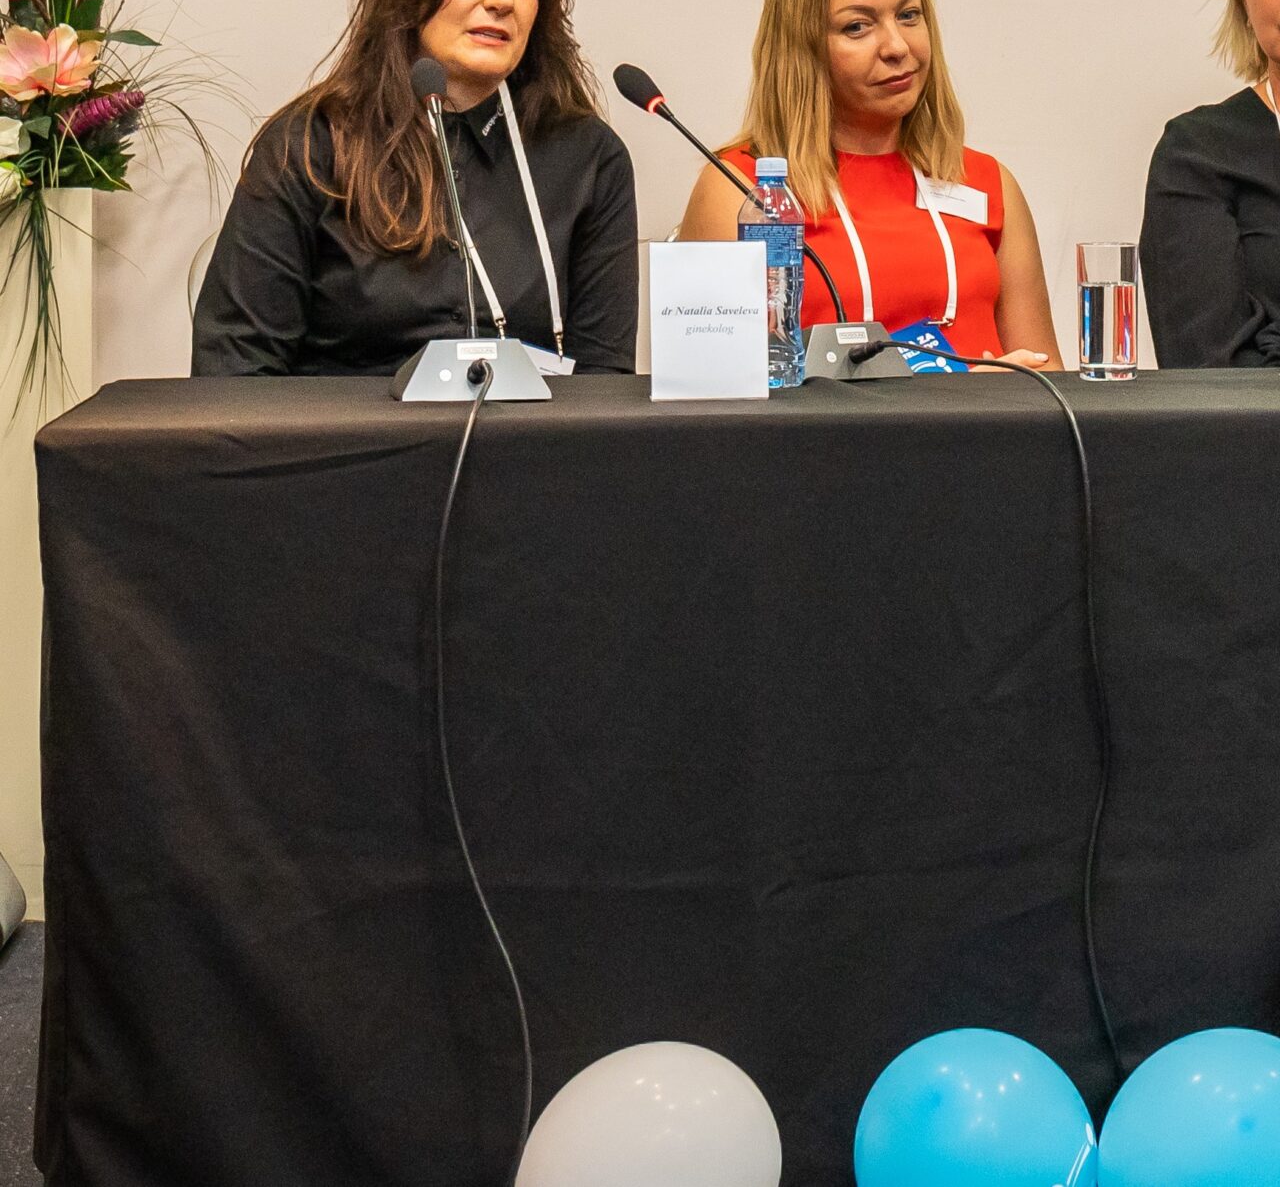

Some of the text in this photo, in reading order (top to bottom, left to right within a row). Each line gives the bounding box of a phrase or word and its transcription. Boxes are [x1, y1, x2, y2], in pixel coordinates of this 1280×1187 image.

[661, 305, 759, 316] dr Natalia Saveleva
[685, 324, 734, 336] ginekolog
[916, 332, 935, 345] ZA
